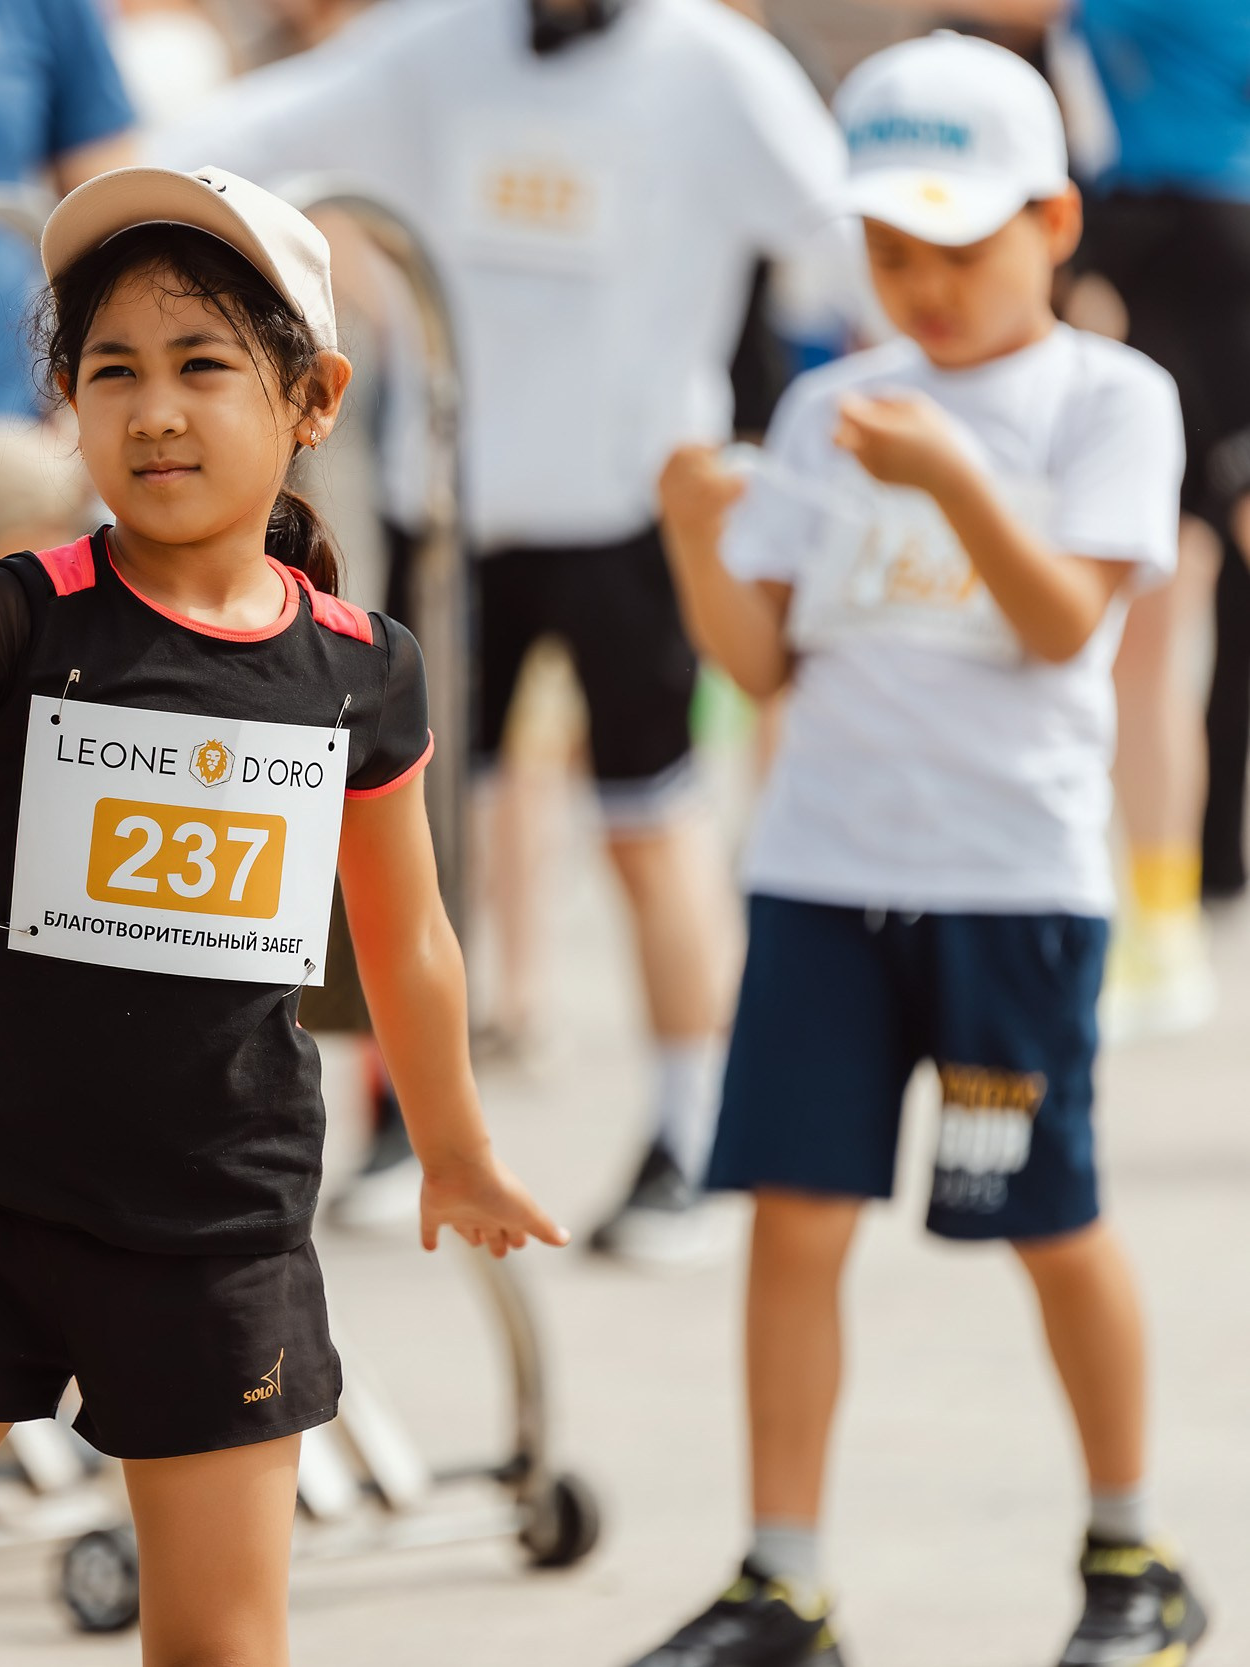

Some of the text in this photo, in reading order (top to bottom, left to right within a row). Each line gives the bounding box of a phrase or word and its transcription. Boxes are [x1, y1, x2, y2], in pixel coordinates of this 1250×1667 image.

[57, 735, 324, 788] LEONE D'ORO
[107, 815, 269, 902] 237
[43, 911, 303, 955] БЛАГОТВОРИТЕЛЬНЫЙ ЗАБЕГ
[243, 1384, 274, 1404] SOLO
